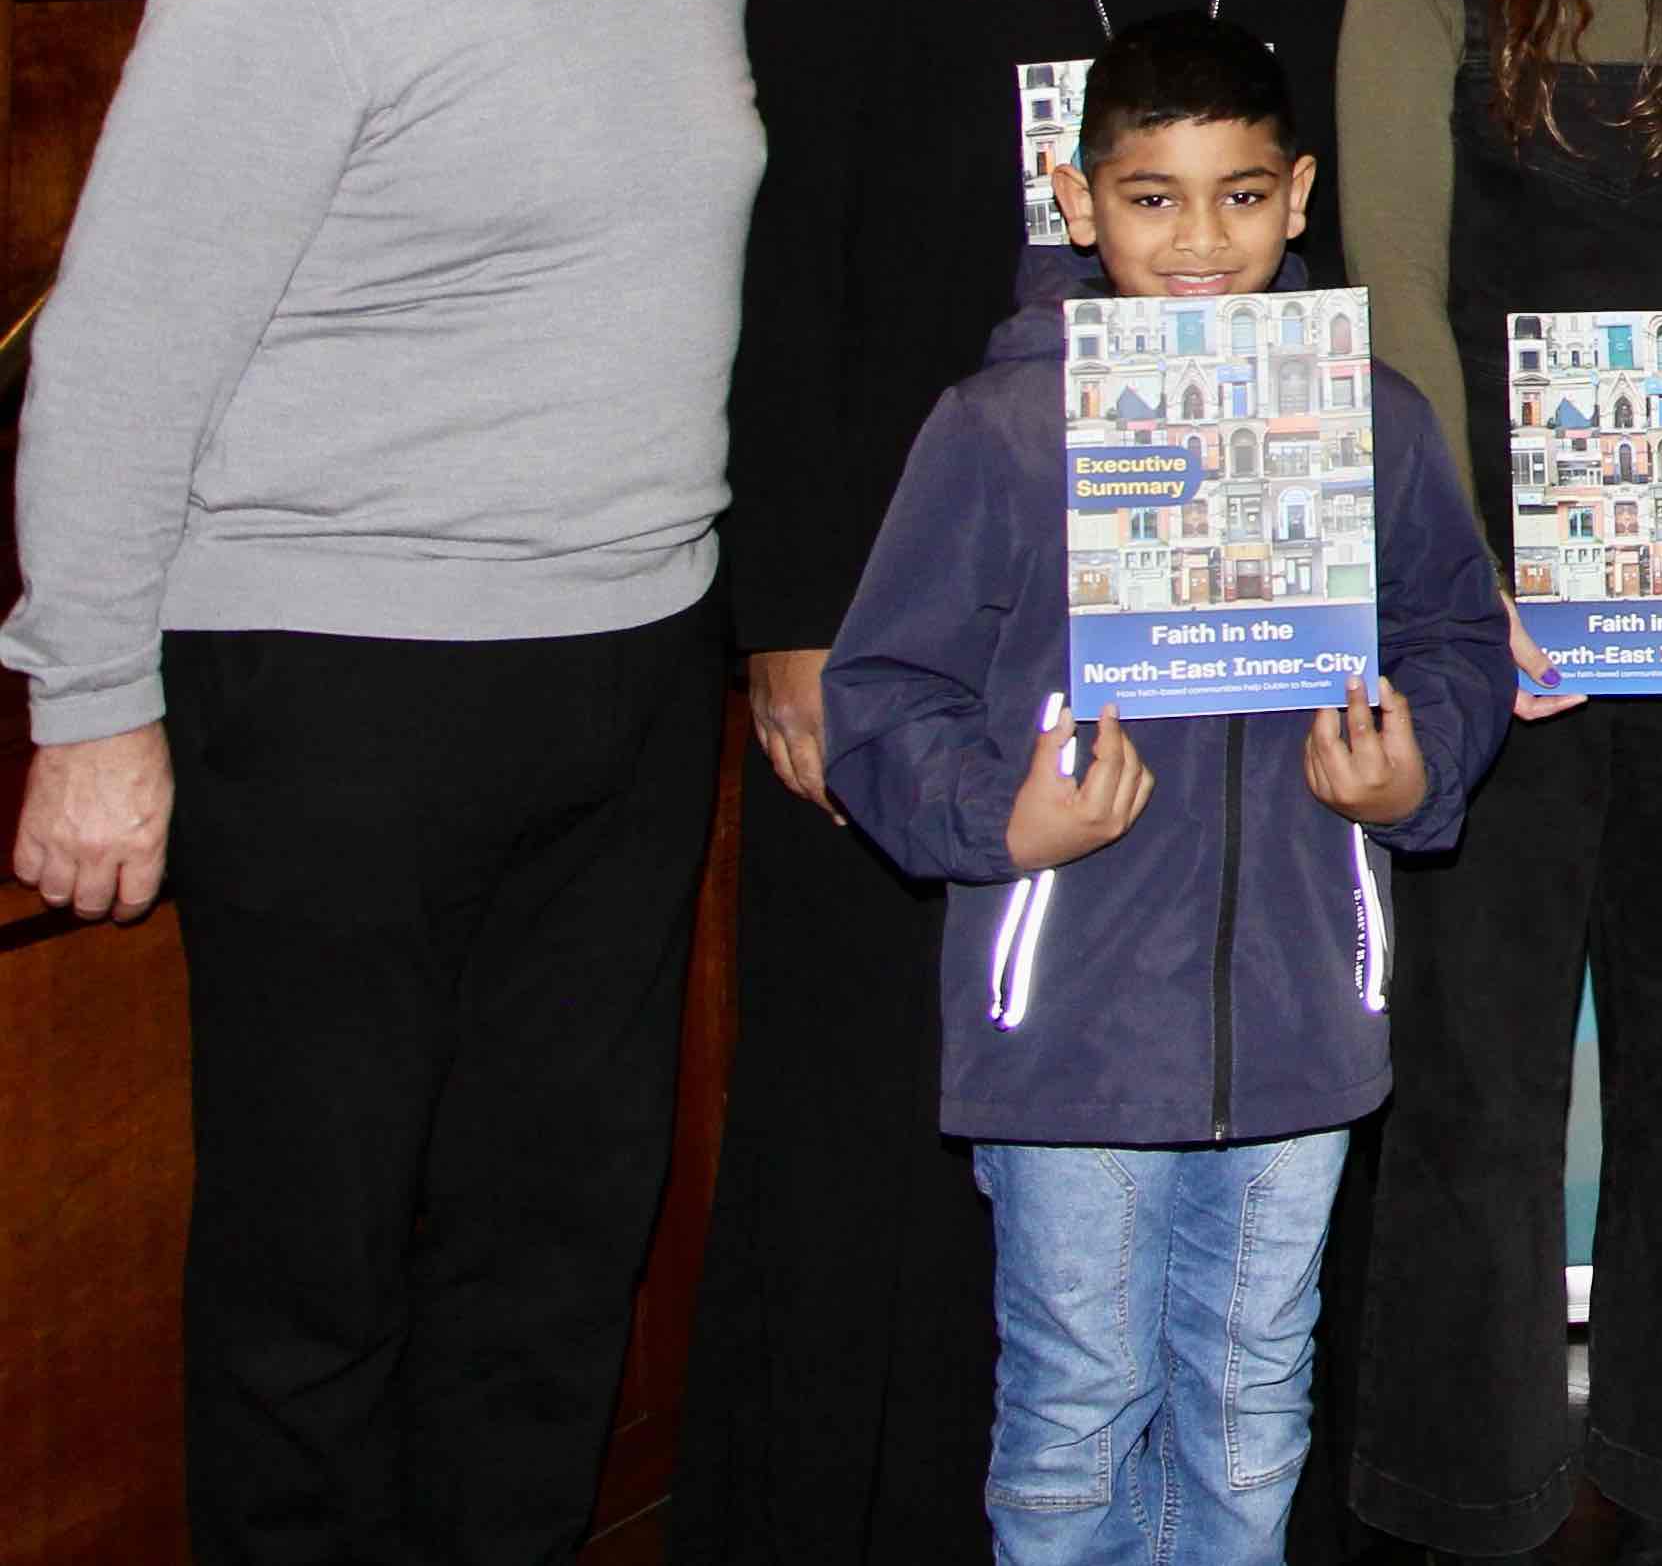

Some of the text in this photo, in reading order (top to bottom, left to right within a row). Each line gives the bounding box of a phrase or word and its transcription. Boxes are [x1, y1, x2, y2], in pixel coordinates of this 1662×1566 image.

[1076, 455, 1186, 474] Executive
[1076, 479, 1185, 498] Summary
[1152, 620, 1293, 645] Faith in the
[1588, 614, 1645, 632] Faith
[1542, 645, 1654, 665] orth-East
[1084, 652, 1367, 683] North-East Inner-City
